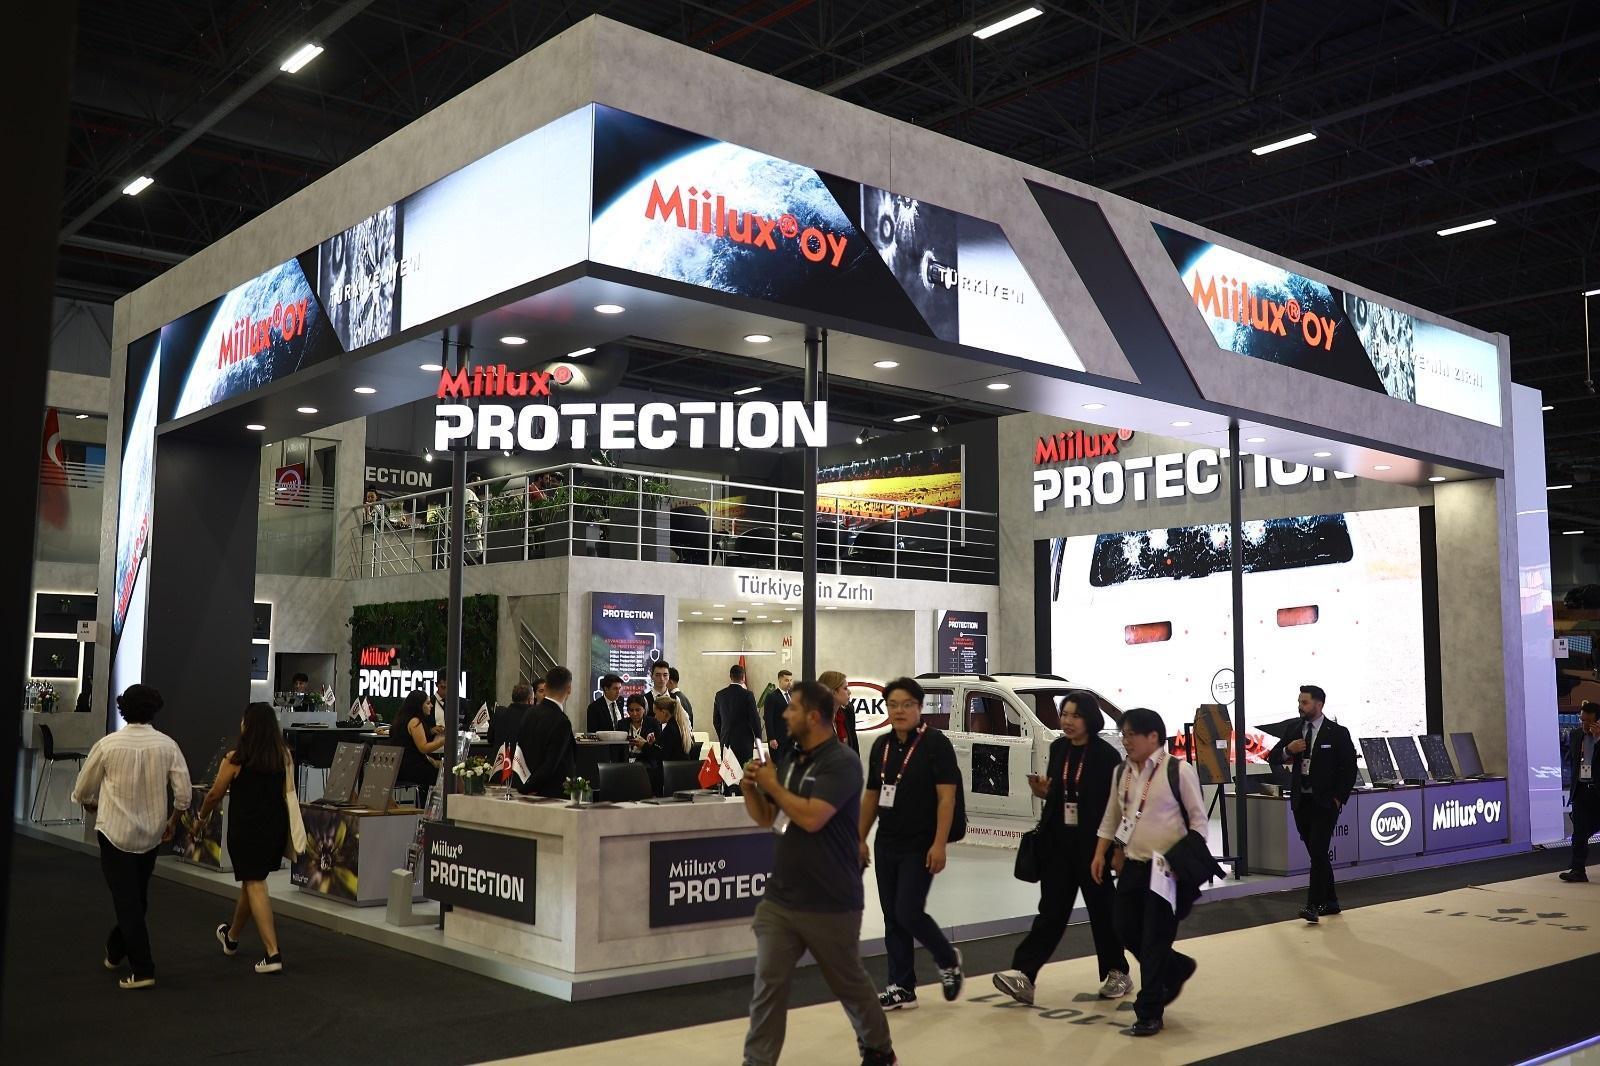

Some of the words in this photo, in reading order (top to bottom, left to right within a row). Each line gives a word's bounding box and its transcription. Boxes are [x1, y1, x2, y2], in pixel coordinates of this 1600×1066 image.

[434, 400, 828, 451] PROTECTION
[365, 466, 433, 488] ECTION
[837, 582, 873, 601] Zırhı
[602, 609, 654, 619] PROTECTION
[948, 620, 979, 630] PROTECTION
[1377, 815, 1405, 833] OYAK
[430, 859, 525, 903] PROTECTION
[668, 872, 773, 907] PROTEC
